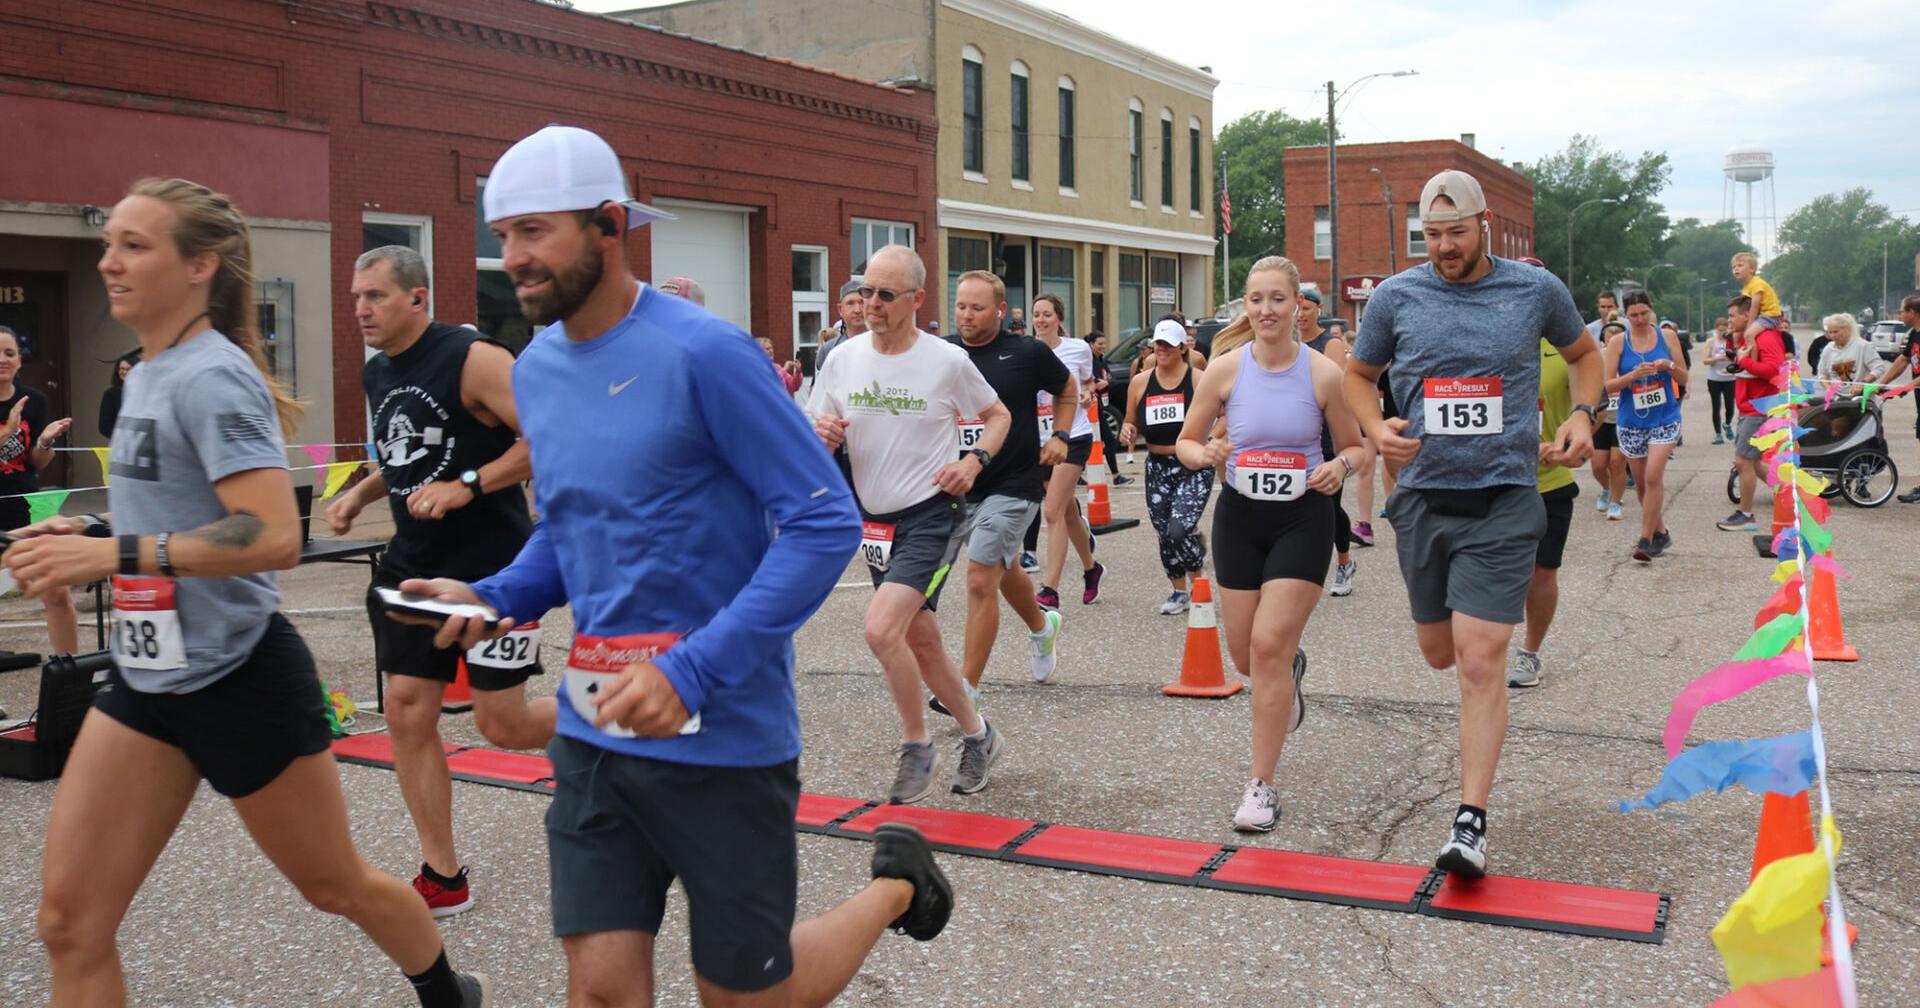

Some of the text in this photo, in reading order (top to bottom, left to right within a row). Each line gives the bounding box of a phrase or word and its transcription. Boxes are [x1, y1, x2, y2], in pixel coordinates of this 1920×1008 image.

[886, 387, 909, 396] 2012
[1435, 384, 1489, 393] RACE RESULT
[1640, 392, 1661, 406] 186
[1153, 407, 1176, 421] 188
[1438, 403, 1488, 428] 153
[1248, 472, 1293, 496] 152
[482, 636, 530, 662] 292
